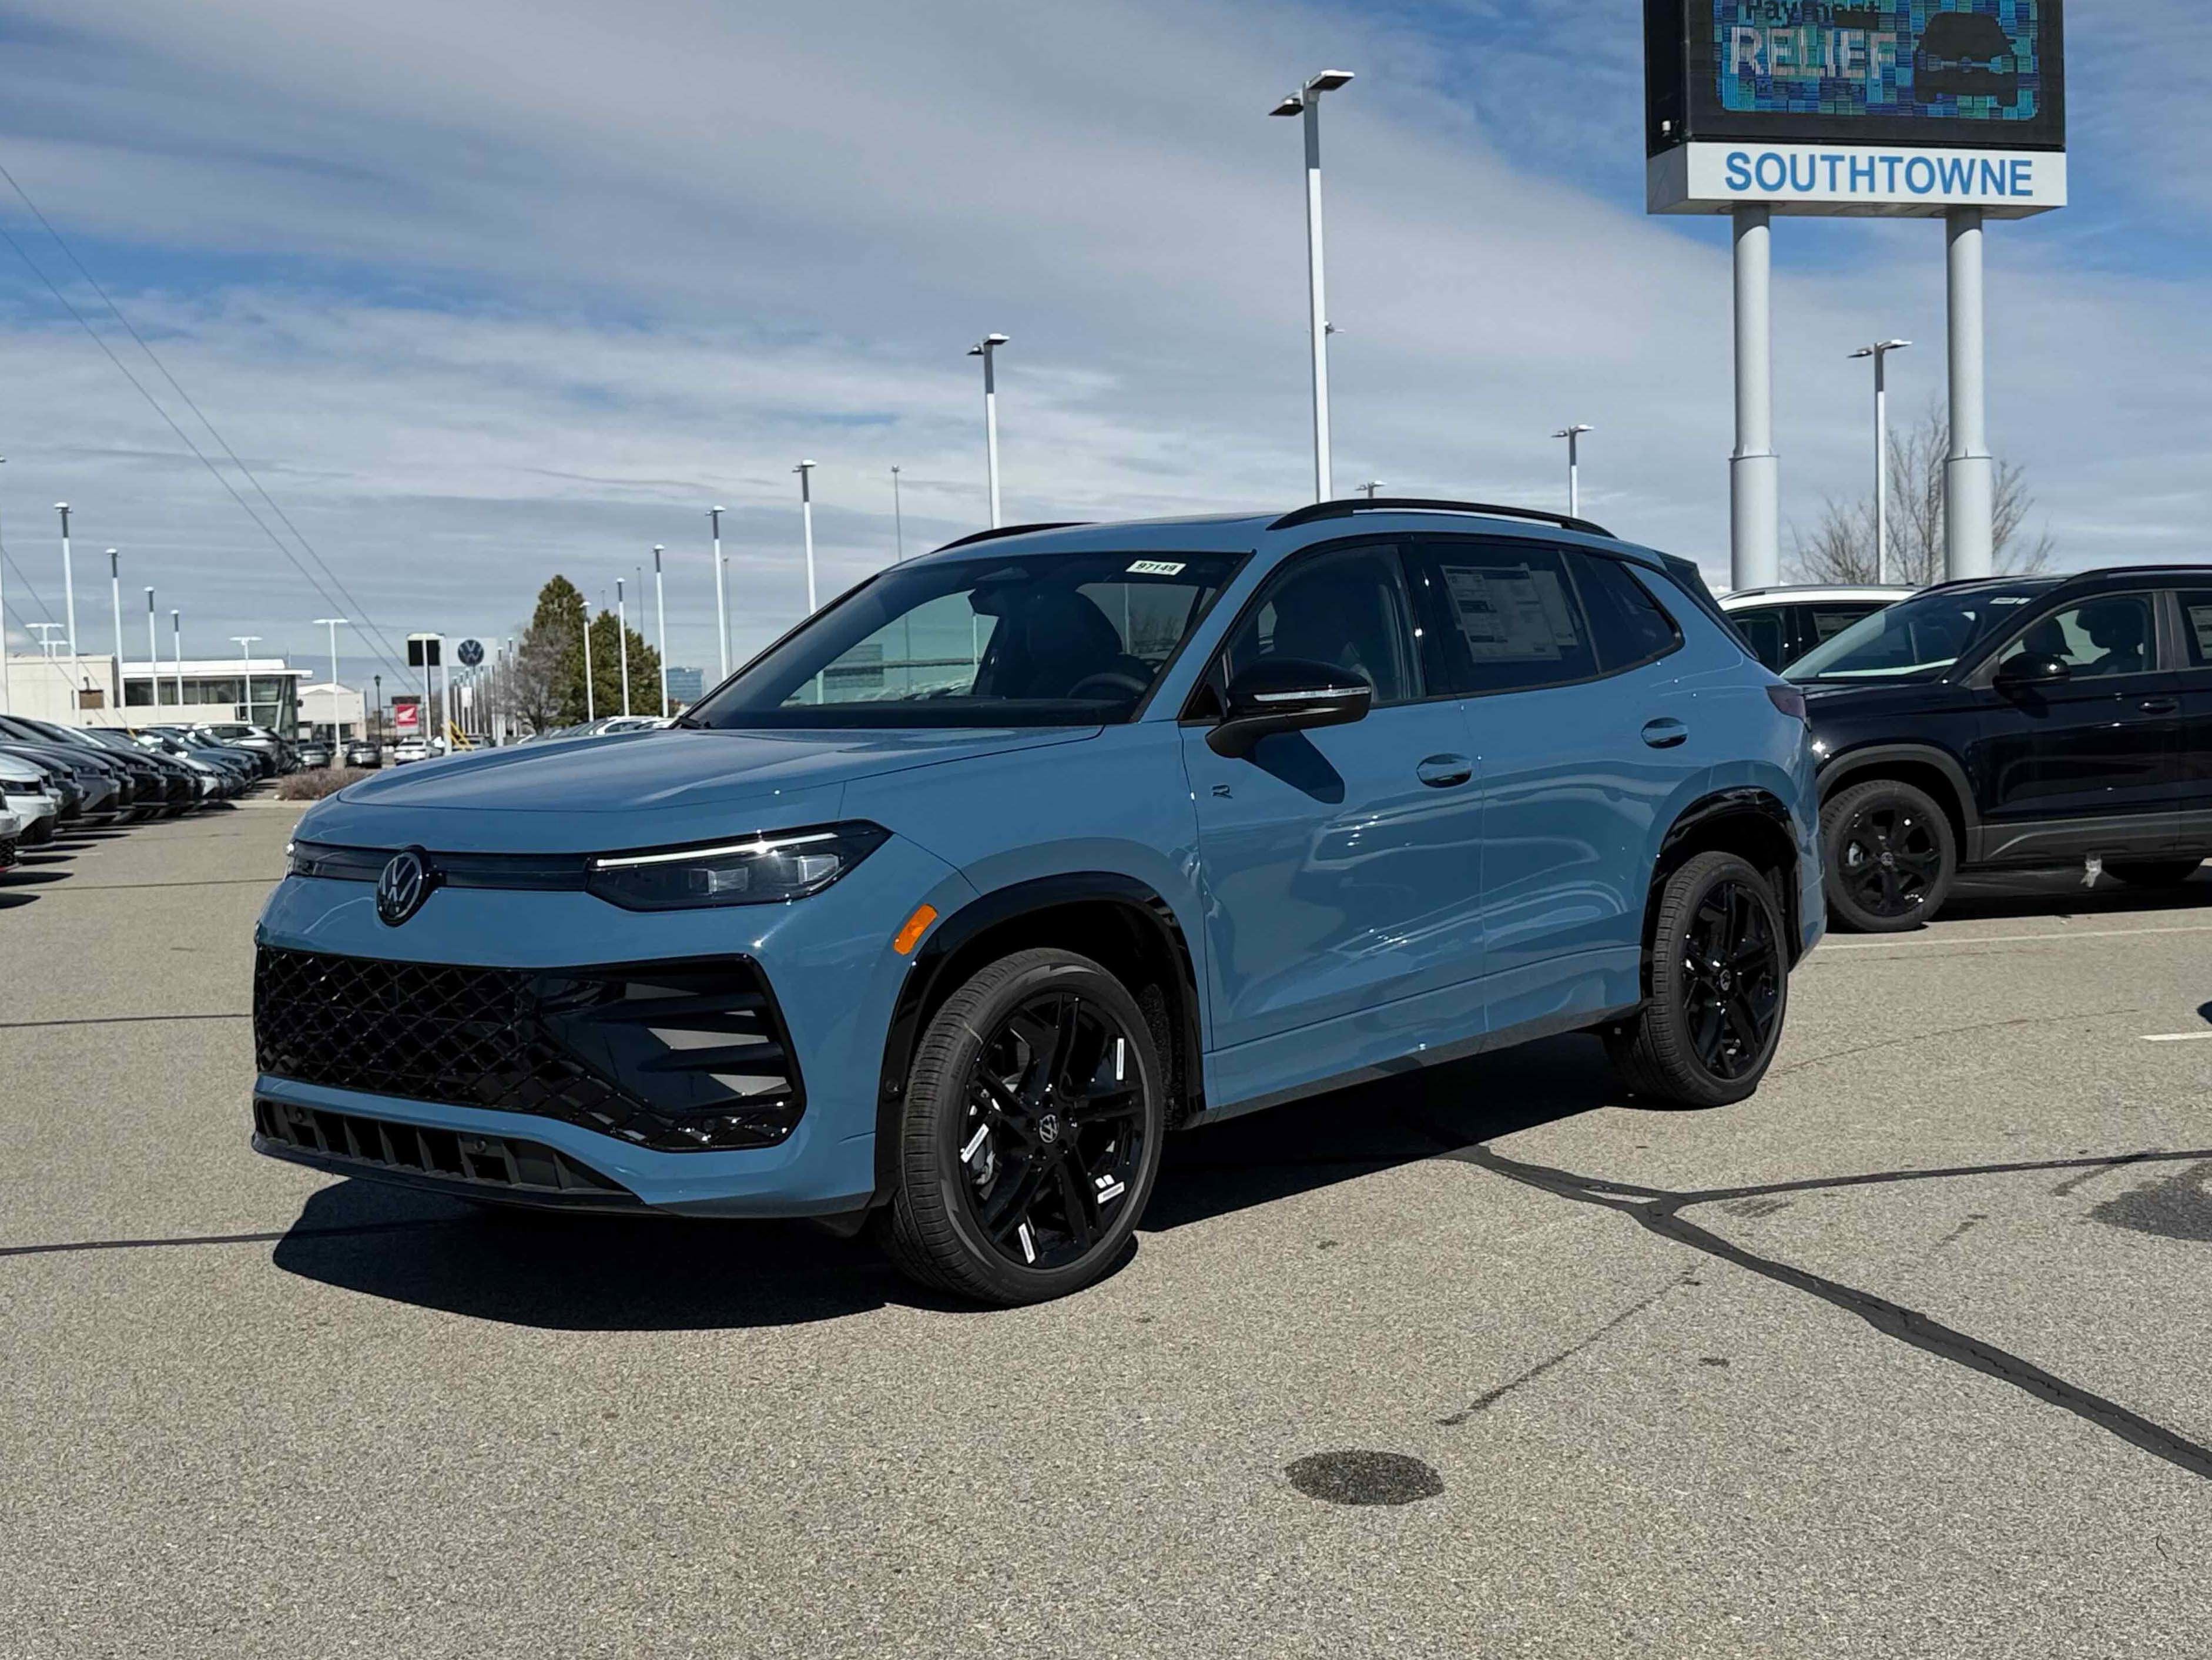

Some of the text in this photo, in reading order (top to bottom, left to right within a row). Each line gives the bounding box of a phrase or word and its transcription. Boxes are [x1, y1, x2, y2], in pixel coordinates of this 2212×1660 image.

[1730, 26, 1896, 79] RELIEF
[1724, 152, 2033, 197] SOUTHTOWNE
[1135, 563, 1178, 572] 97149
[458, 640, 484, 667] VW
[378, 852, 423, 919] VW
